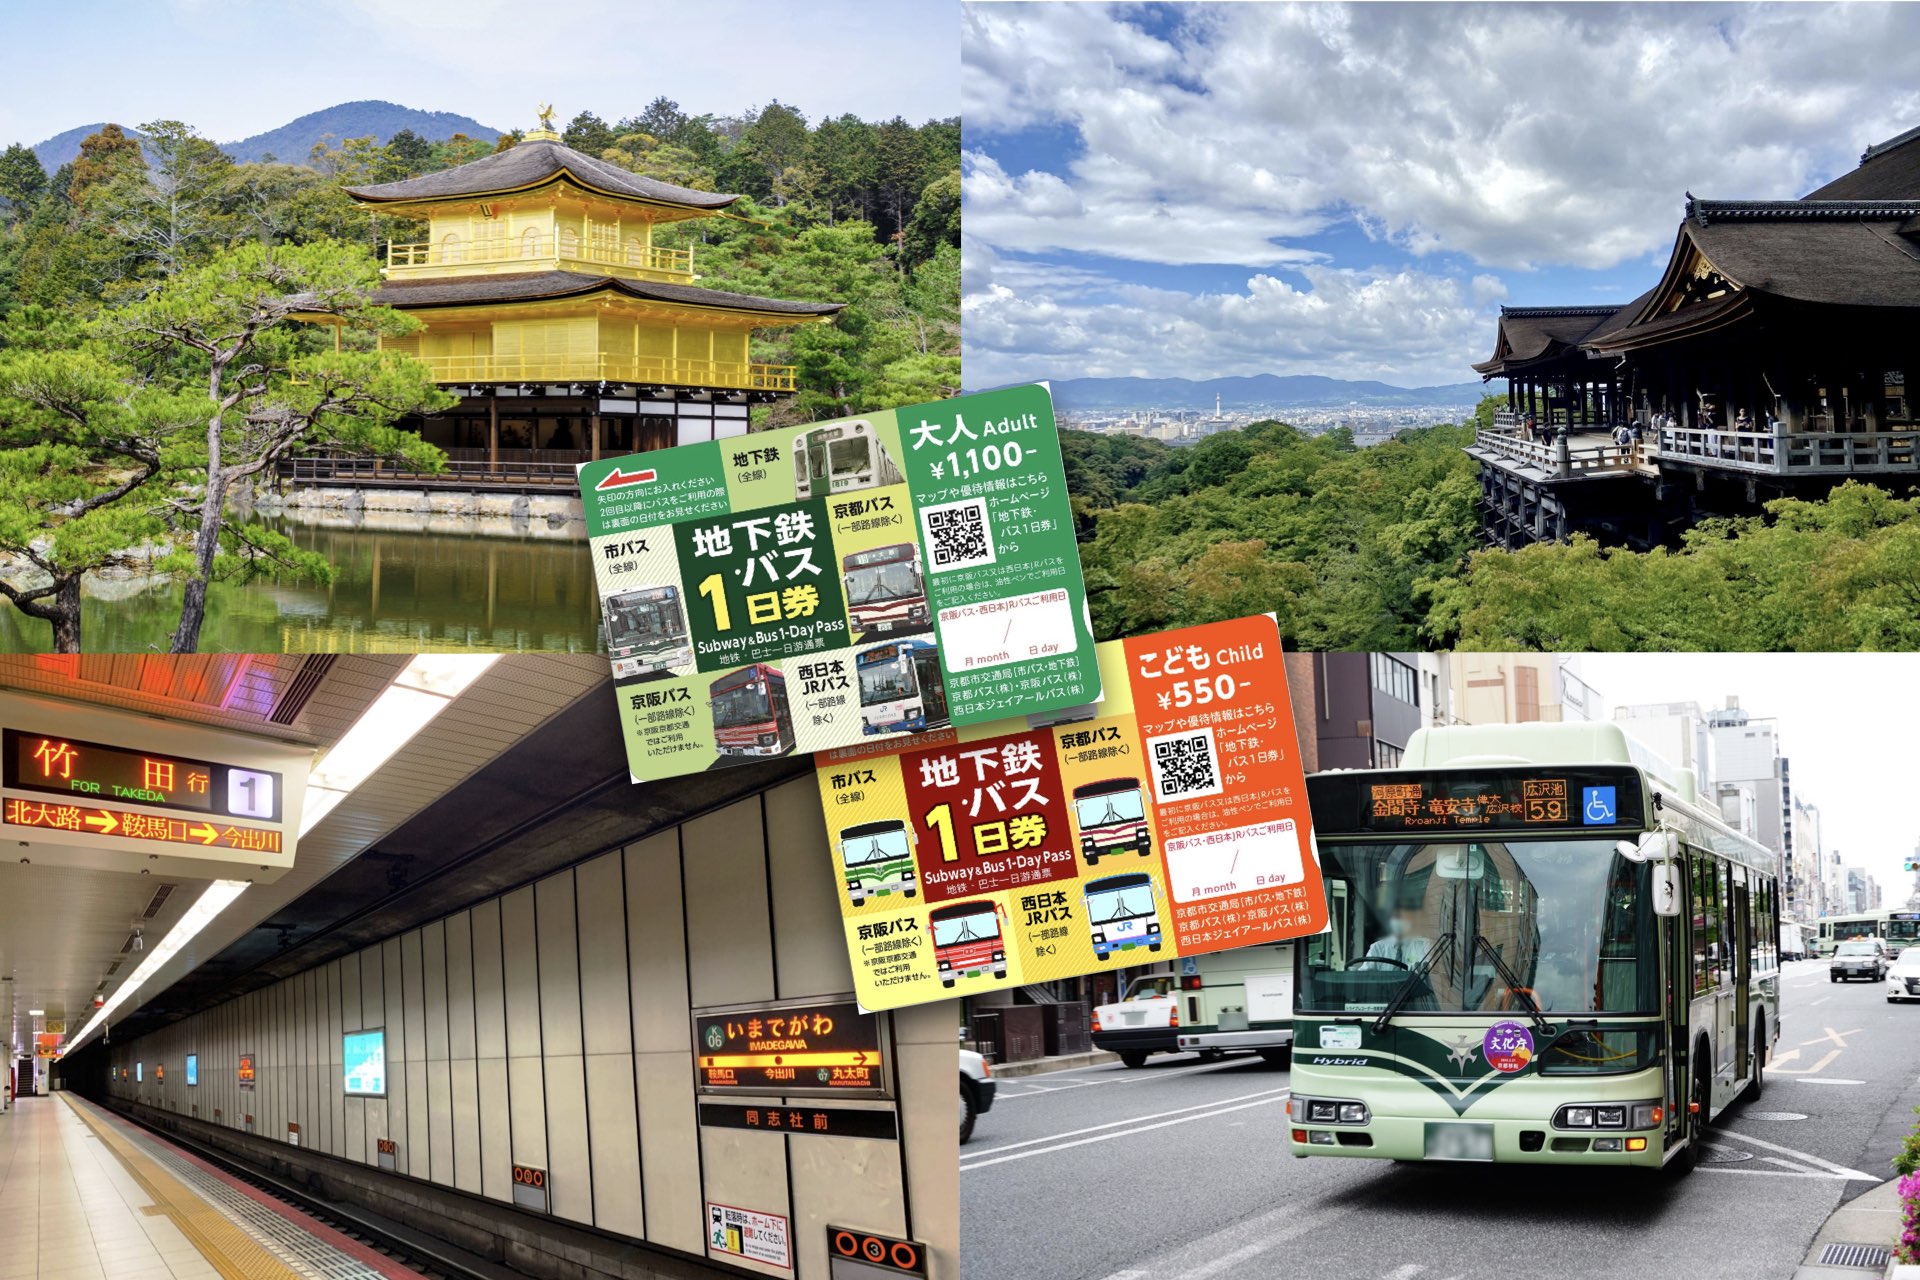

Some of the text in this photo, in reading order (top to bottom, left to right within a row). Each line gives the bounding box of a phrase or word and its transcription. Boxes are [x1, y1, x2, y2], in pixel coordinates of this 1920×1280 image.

[909, 413, 1038, 451] 大人 Adult
[733, 446, 780, 468] 地下鉄
[597, 476, 715, 505] 矢印の方向にお入れください
[915, 471, 1048, 505] マップや優待情報はこちら
[989, 487, 1051, 508] ホームページ
[600, 486, 726, 518] 2回目以降にバスをご利用の際
[833, 495, 895, 519] 京都バス
[602, 500, 728, 530] は裏面の日付をお見せください
[692, 510, 817, 558] 地下鉄
[604, 539, 650, 559] 市バス
[998, 541, 1020, 555] から
[815, 618, 845, 634] Pass
[976, 650, 1010, 665] month
[1029, 643, 1059, 656] 日 day
[797, 660, 845, 680] 西日本
[1139, 642, 1264, 679] こども Child
[801, 676, 851, 696] JRバス
[630, 687, 692, 710] 京阪バス
[1142, 702, 1276, 735] マップや優待情報はこちら
[1216, 717, 1278, 739] ホームページ
[646, 732, 684, 746] ではご利用
[1060, 726, 1121, 750] 京都バス
[647, 742, 704, 757] いただけません。
[919, 740, 1044, 789] 地下鉄
[831, 769, 877, 790] 市バス
[1224, 771, 1247, 786] から
[70, 779, 166, 803] FOR TAKEDA
[239, 776, 256, 812] 1
[1372, 783, 1565, 800] 河原町通 広沢池
[1372, 797, 1477, 817] 金閣寺・竜安寺
[1530, 800, 1563, 820] 59
[6, 799, 281, 853] 北大路 鞍馬口 今出川
[1405, 814, 1491, 827] Ryoanji Temple
[1043, 847, 1073, 865] Pass
[1204, 879, 1237, 895] month
[1256, 873, 1286, 886] 日 day
[1021, 890, 1068, 911] 西日本
[1025, 906, 1073, 926] JRバス
[857, 917, 919, 940] 京阪バス
[1116, 921, 1134, 933] JR
[873, 963, 911, 977] ではご利用
[874, 971, 932, 988] いただけません。
[727, 1013, 834, 1041] いまでがわ
[707, 1034, 723, 1048] 06
[749, 1039, 808, 1052] IMADEGAWA
[1489, 1036, 1528, 1051] 文化庁
[1313, 1056, 1369, 1066] Hybrid
[764, 1067, 796, 1081] 今出川
[832, 1067, 870, 1081] 丸太町
[746, 1110, 829, 1131] 同志社前
[869, 1243, 880, 1257] 3
